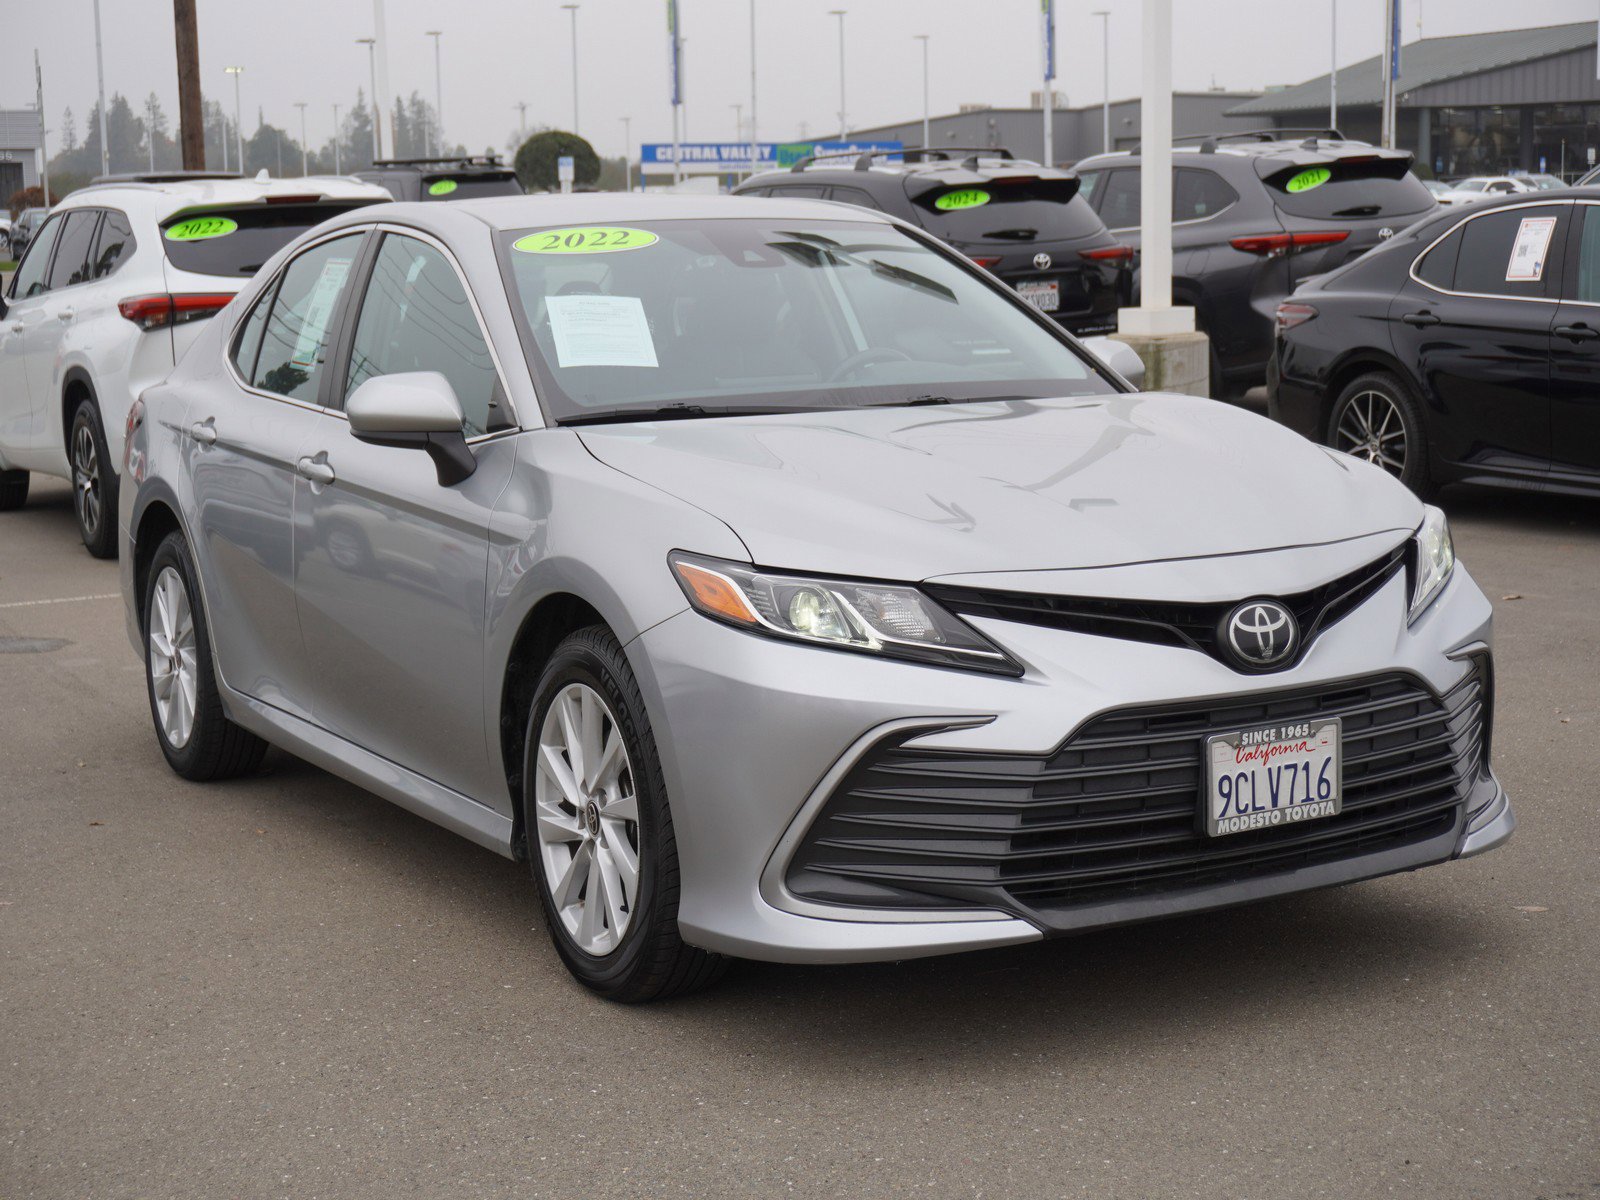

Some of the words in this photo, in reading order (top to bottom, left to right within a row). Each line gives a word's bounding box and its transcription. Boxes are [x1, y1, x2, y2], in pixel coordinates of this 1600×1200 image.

[177, 221, 224, 237] 2022
[541, 230, 630, 250] 2022
[1241, 728, 1276, 745] SINCE
[1281, 724, 1309, 739] 1965
[1235, 741, 1316, 766] California
[1218, 756, 1332, 818] 9CLV716
[1217, 811, 1281, 834] MODESTO
[1285, 801, 1335, 821] TOYOTA
